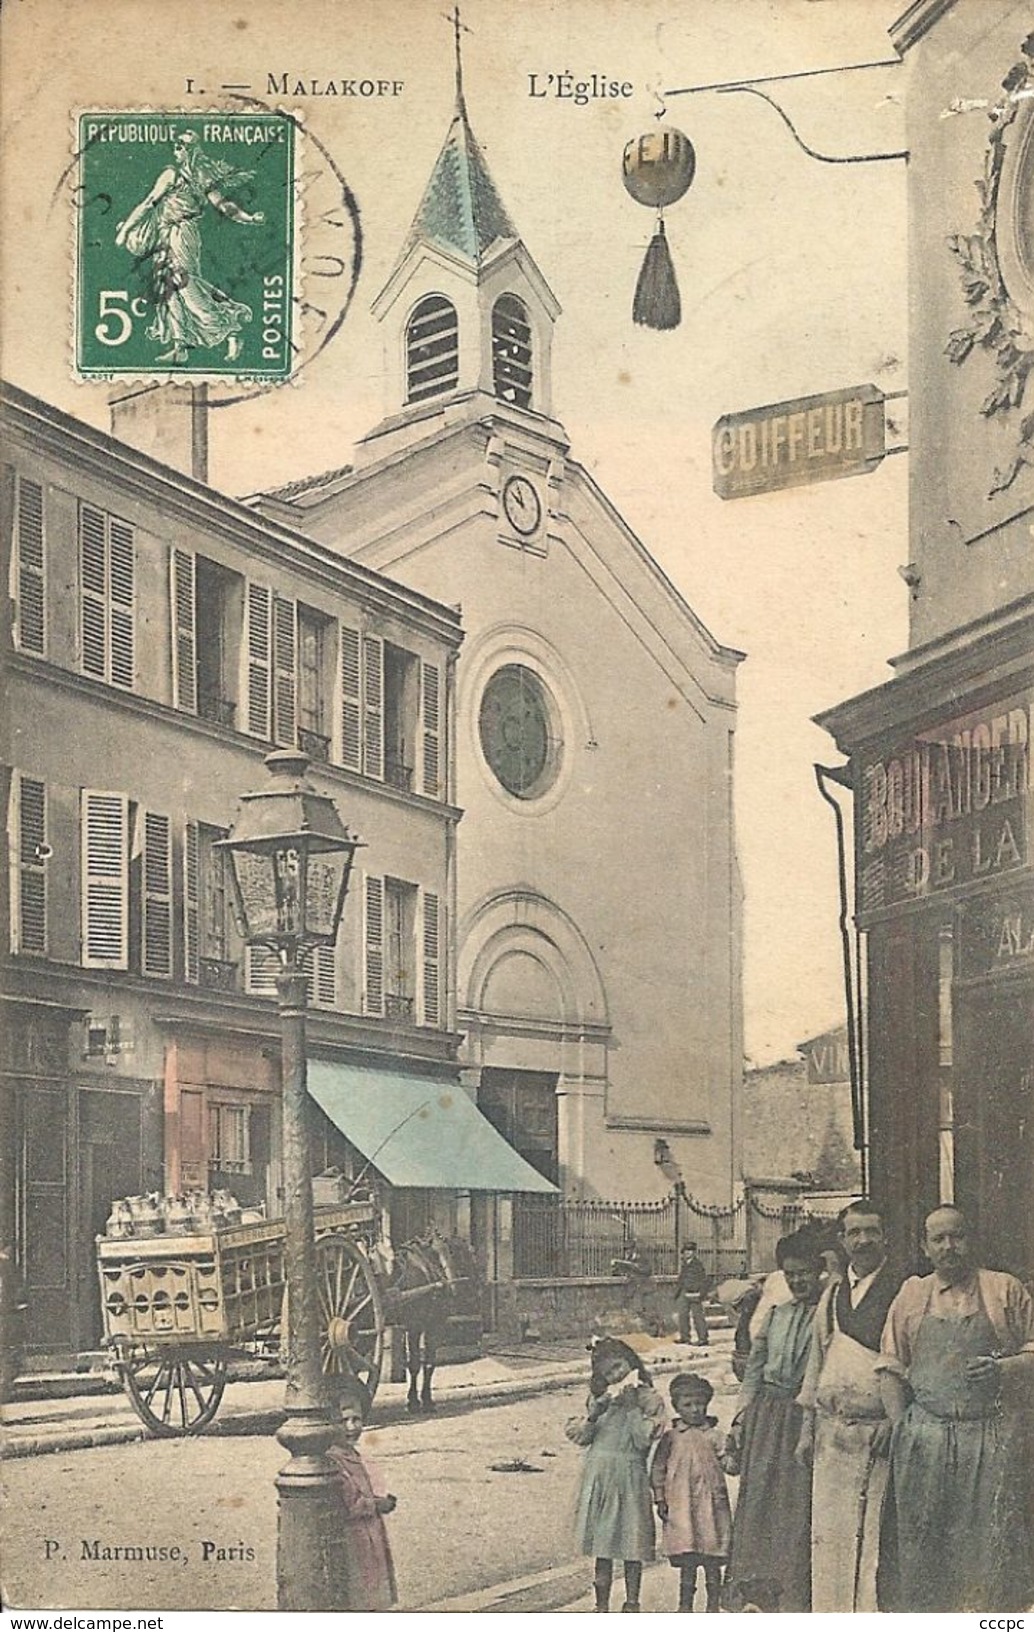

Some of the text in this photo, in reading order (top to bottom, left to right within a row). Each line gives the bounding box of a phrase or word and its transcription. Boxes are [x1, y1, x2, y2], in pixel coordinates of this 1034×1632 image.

[203, 123, 286, 146] FRANÇAISE
[262, 274, 284, 360] POSTES
[714, 397, 864, 475] COIFFEUR
[972, 819, 1022, 872] LA
